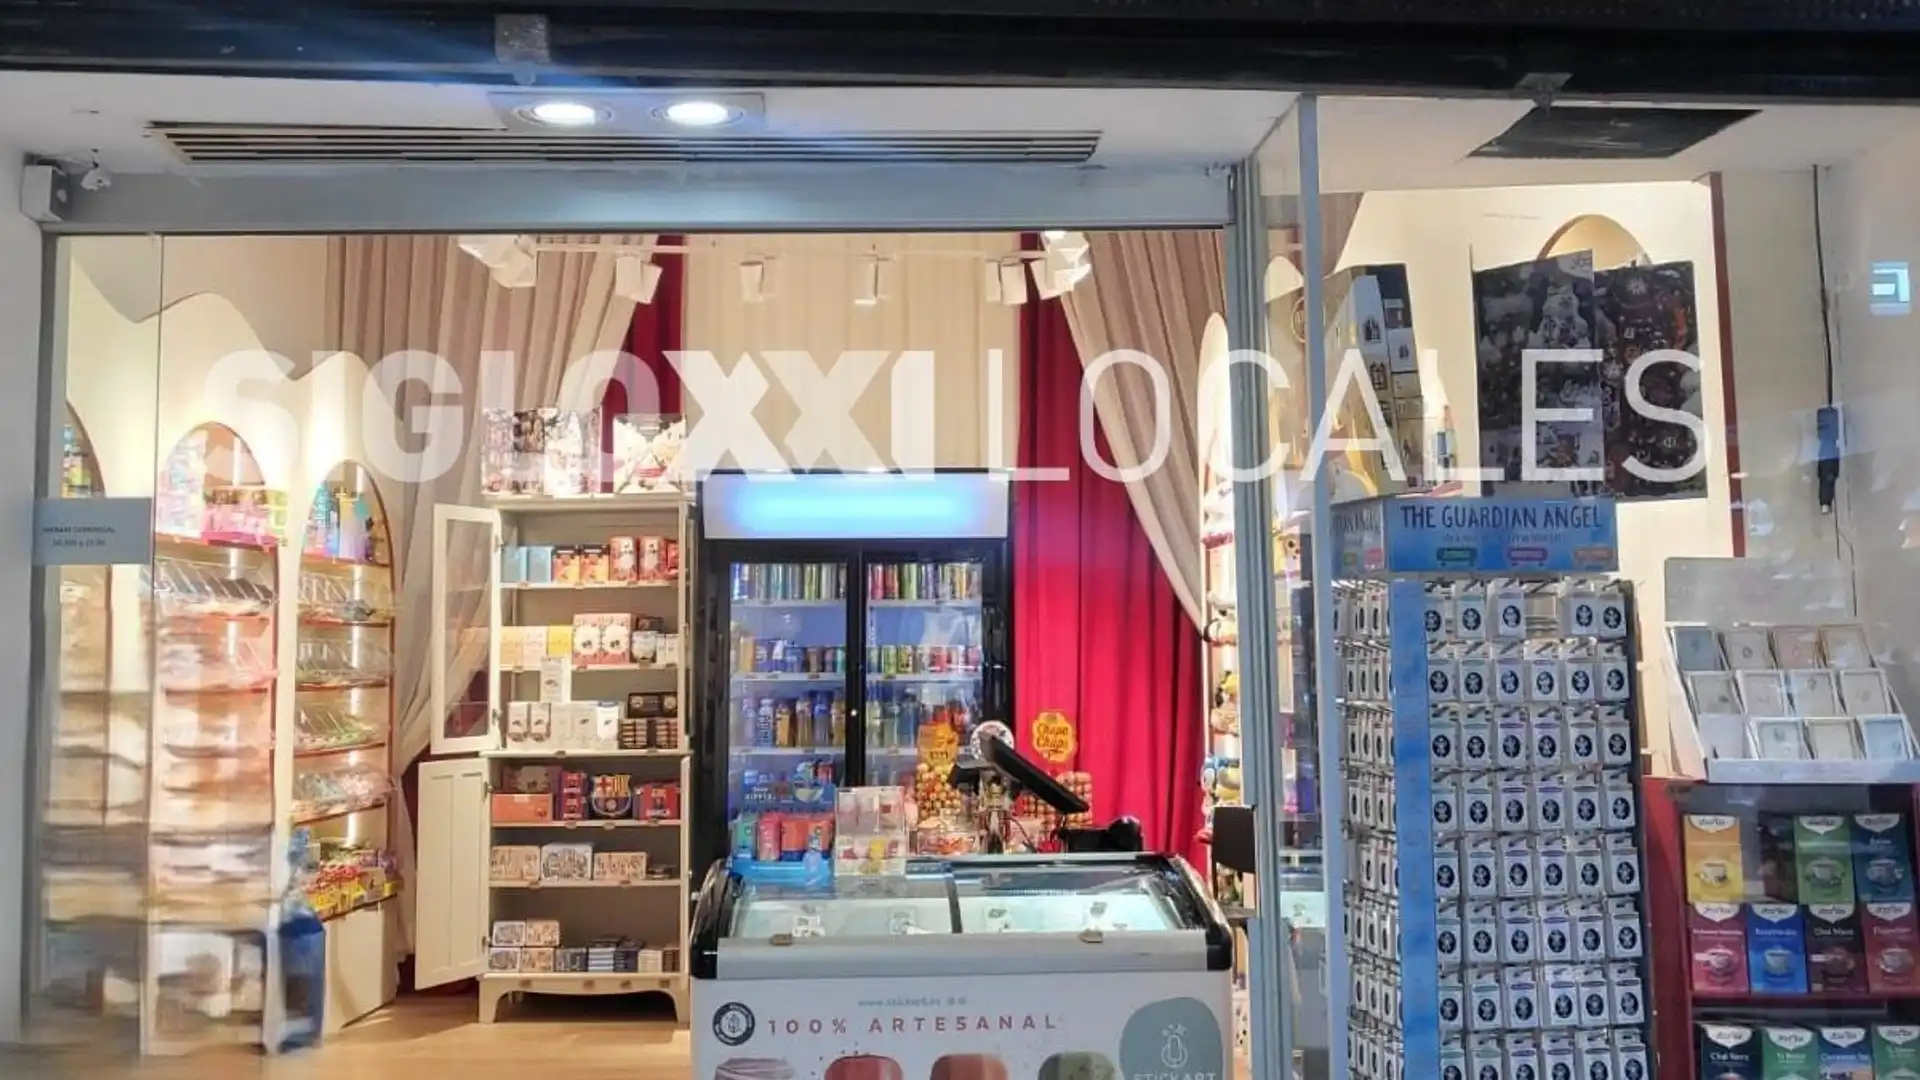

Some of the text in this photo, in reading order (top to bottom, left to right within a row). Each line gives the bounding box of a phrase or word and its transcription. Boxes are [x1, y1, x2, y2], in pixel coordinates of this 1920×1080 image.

[1400, 505, 1437, 529] THE
[1441, 505, 1537, 530] GUARDIAN
[1543, 505, 1605, 529] ANGEL
[767, 1018, 847, 1035] 100%
[867, 1014, 1057, 1034] ARTESANAL
